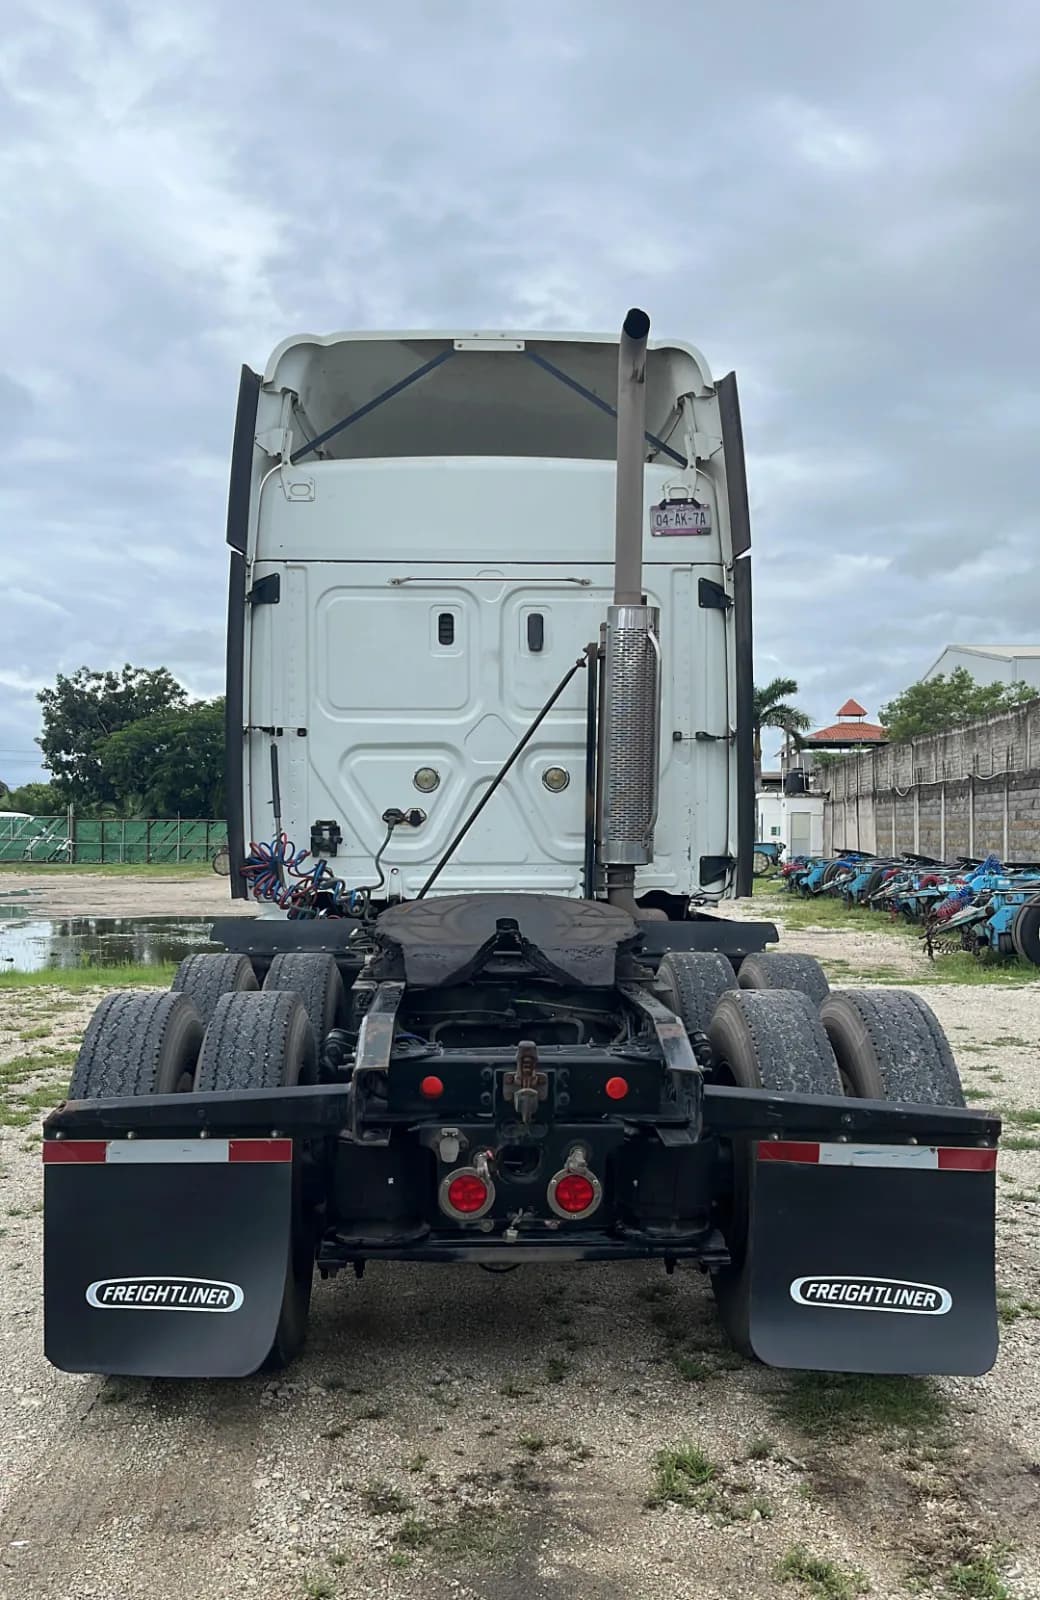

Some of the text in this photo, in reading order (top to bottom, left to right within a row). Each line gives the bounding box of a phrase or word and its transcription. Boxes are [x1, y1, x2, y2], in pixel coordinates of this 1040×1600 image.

[656, 512, 706, 526] 04-AK-7A
[102, 1285, 230, 1305] FREIGHTLINER
[806, 1283, 937, 1308] FREIGHTLINER
